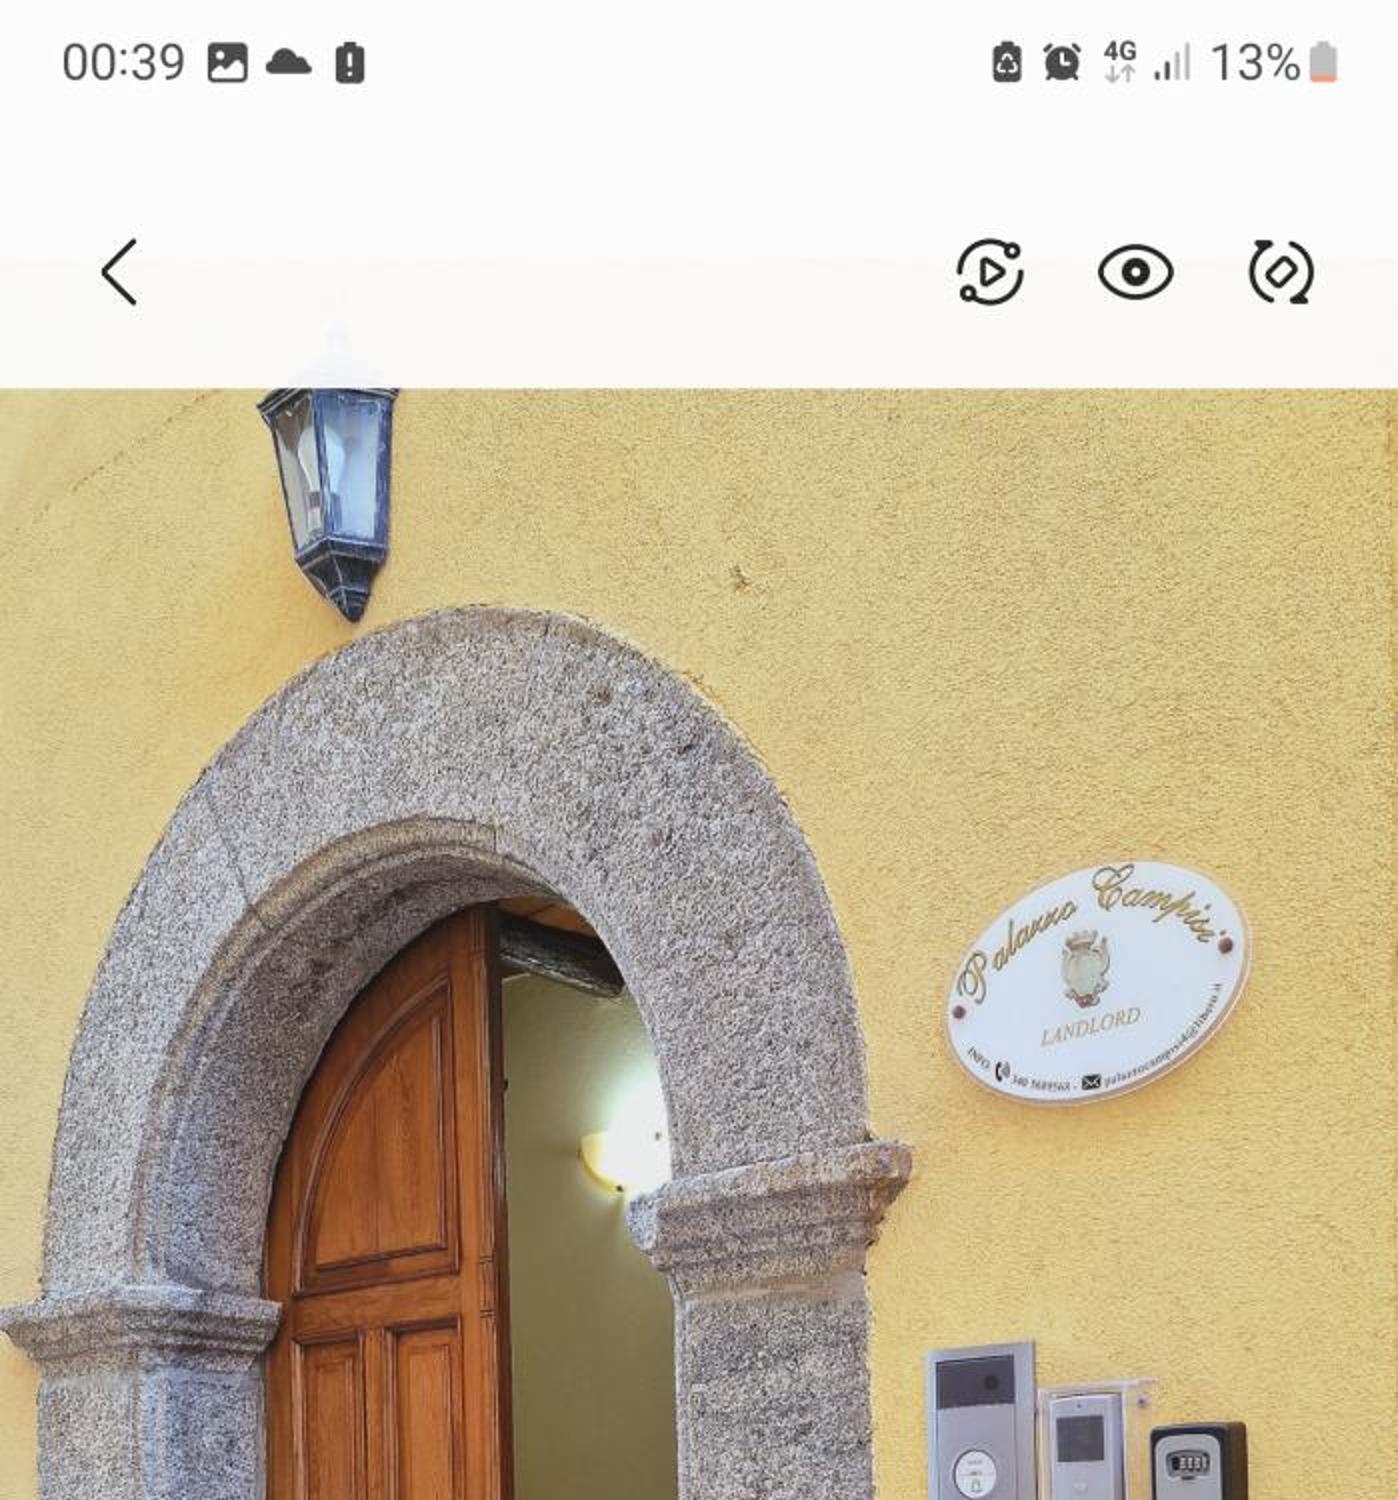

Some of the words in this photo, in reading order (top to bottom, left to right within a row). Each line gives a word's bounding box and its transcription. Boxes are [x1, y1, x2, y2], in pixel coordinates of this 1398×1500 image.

[63, 42, 185, 81] 00:39
[1103, 39, 1137, 61] 4G
[1211, 42, 1301, 81] 13%
[957, 901, 1078, 1004] Palazzo
[1092, 864, 1228, 943] Campisi
[1041, 1008, 1140, 1046] LANDLORD
[967, 1046, 990, 1069] INFO
